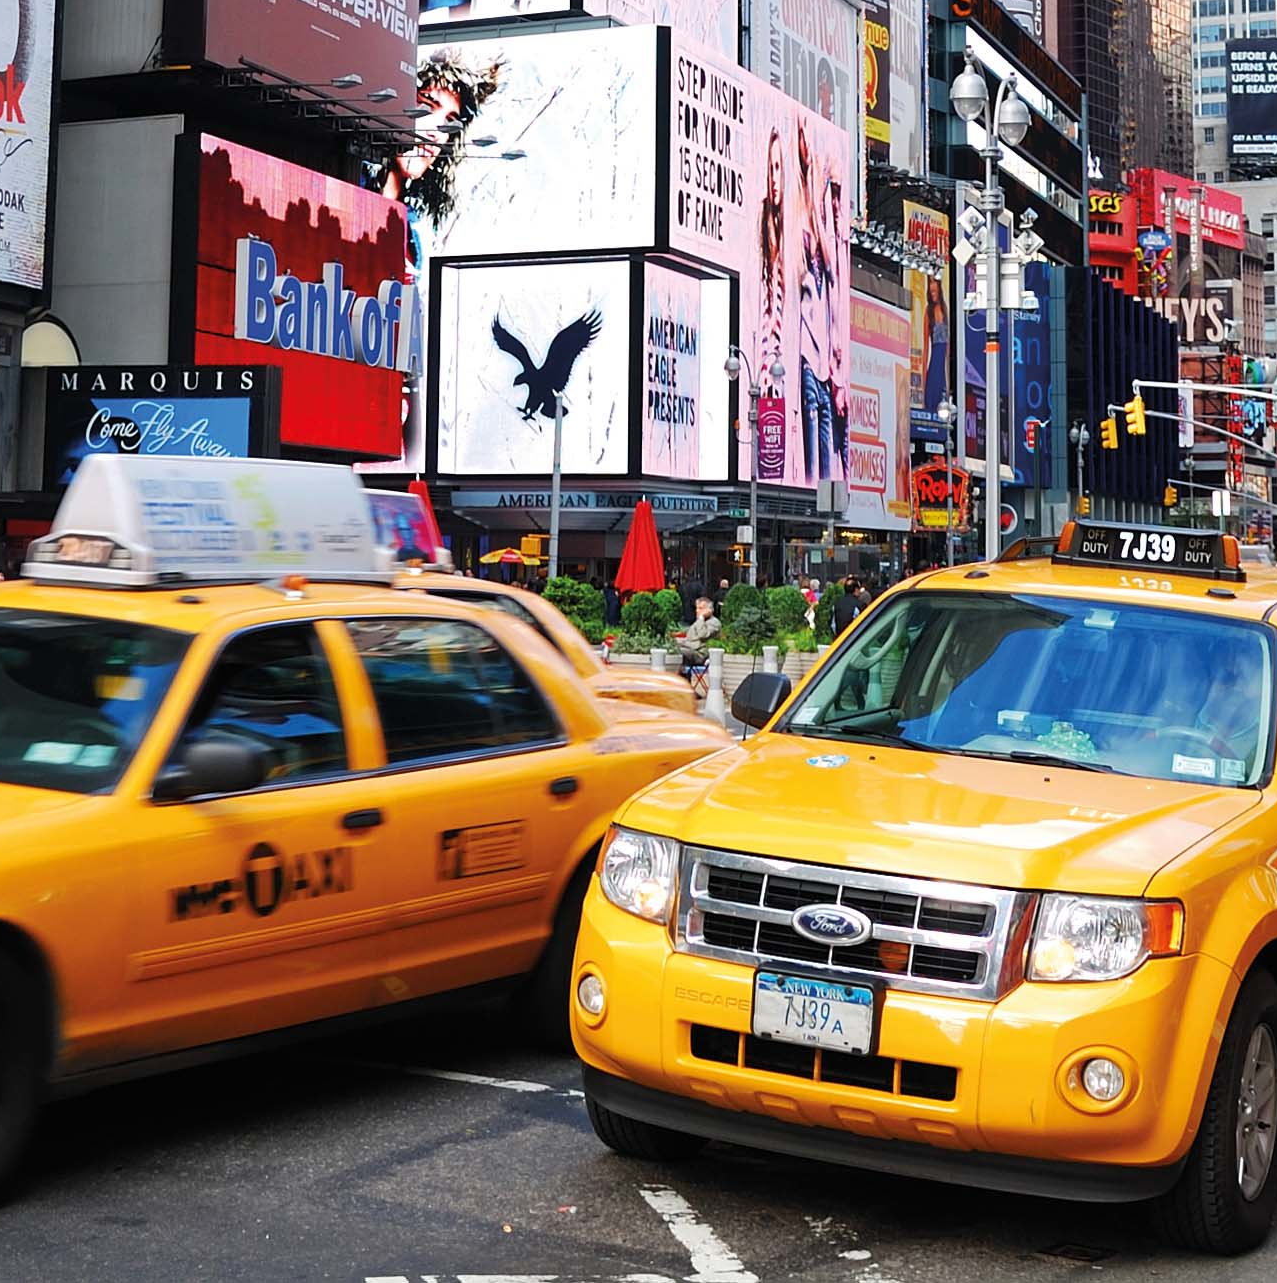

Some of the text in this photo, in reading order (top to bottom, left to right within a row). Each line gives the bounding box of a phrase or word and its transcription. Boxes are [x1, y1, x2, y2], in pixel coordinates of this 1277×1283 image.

[1231, 51, 1267, 61] BEFORE
[1269, 51, 1277, 60] A
[1231, 62, 1264, 71] TURNS
[1232, 74, 1265, 83] UPSIDE
[1232, 85, 1244, 94] BE
[678, 56, 744, 124] STEP INSIDE
[678, 100, 731, 160] FOR YOUR
[679, 144, 743, 207] 15 SECONDS
[1089, 193, 1122, 213] se's
[678, 189, 723, 241] OF FAME
[234, 238, 403, 369] Bank of
[648, 316, 696, 356] AMERICAN
[61, 371, 254, 391] MARQUIS
[648, 352, 676, 388] EAGLE
[648, 389, 695, 427] PRESENTS
[86, 407, 138, 448] Come
[121, 401, 175, 452] Fly
[1087, 529, 1107, 541] OFF
[1189, 538, 1208, 551] OFF
[1082, 541, 1109, 555] DUTY
[1119, 531, 1176, 562] 7J39
[1184, 550, 1212, 564] DUTY
[810, 913, 846, 935] Ford
[675, 987, 751, 1011] ESCAPE
[785, 981, 844, 1001] NEW YORK
